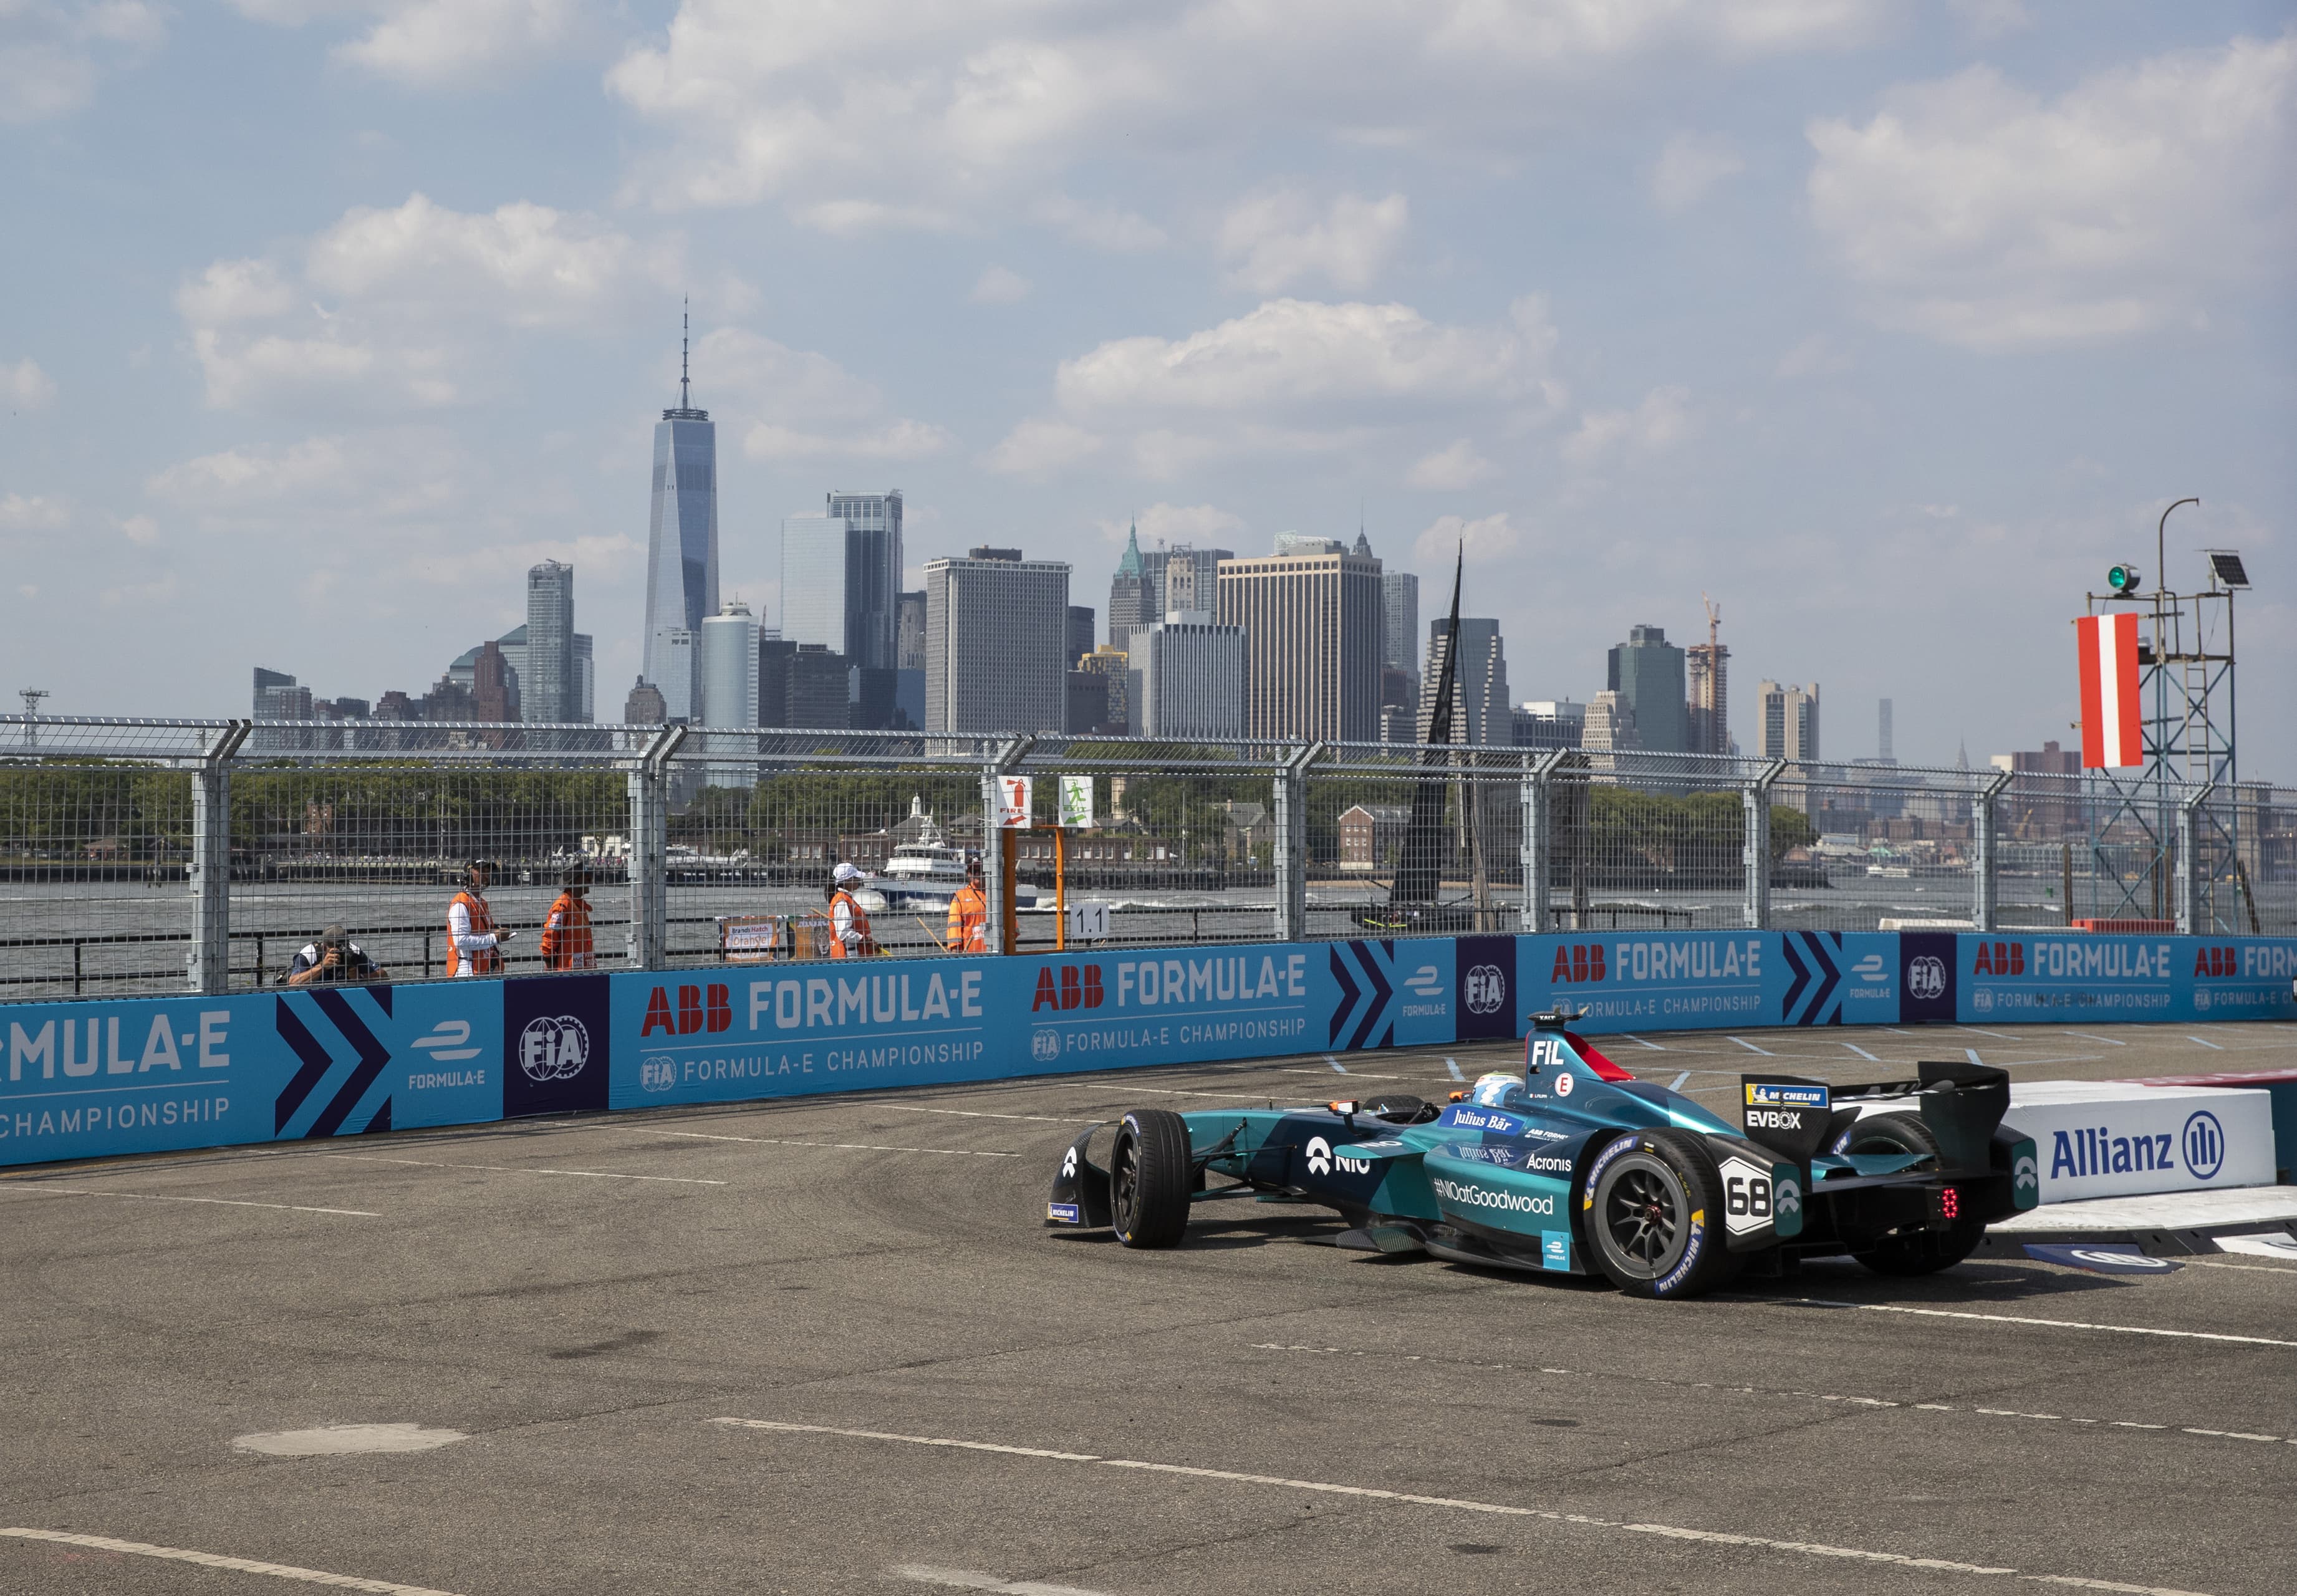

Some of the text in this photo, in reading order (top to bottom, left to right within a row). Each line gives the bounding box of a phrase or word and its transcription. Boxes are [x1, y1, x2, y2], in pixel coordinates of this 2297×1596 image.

[1076, 907, 1104, 934] 1.1
[1551, 944, 1606, 984] ABB
[1973, 941, 2025, 976] ABB
[2194, 946, 2237, 978] ABB
[1031, 964, 1104, 1012] ABB
[1997, 992, 2071, 1009] FORMULA-E
[2078, 992, 2171, 1009] CHAMPIONSHIP
[2214, 991, 2276, 1006] FORMULA-E
[640, 983, 732, 1037] ABB
[1577, 997, 1655, 1017] FORMULA-E
[1664, 995, 1761, 1015] CHAMPIONSHIP
[0, 1011, 230, 1081] MULA-E
[1067, 1027, 1168, 1052] FORMULA-E
[1180, 1018, 1306, 1044] CHAMPIONSHIP
[685, 1054, 813, 1082] FORMULA-E
[828, 1041, 983, 1072] CHAMPIONSHIP
[1531, 1041, 1564, 1065] FIL
[1560, 1077, 1568, 1092] E
[1769, 1092, 1821, 1101] MCHELIN
[0, 1097, 229, 1138] CHAMPIONSHIP
[1453, 1109, 1512, 1132] Julius Bär
[1746, 1110, 1801, 1130] EVBOX
[1526, 1153, 1572, 1172] Acronis
[1589, 1138, 1633, 1185] MICHELIN
[2050, 1127, 2174, 1180] Allianz
[1434, 1178, 1553, 1215] #NIOatGoodwood
[1727, 1176, 1771, 1217] 68
[1659, 1237, 1700, 1292] MICHELIN
